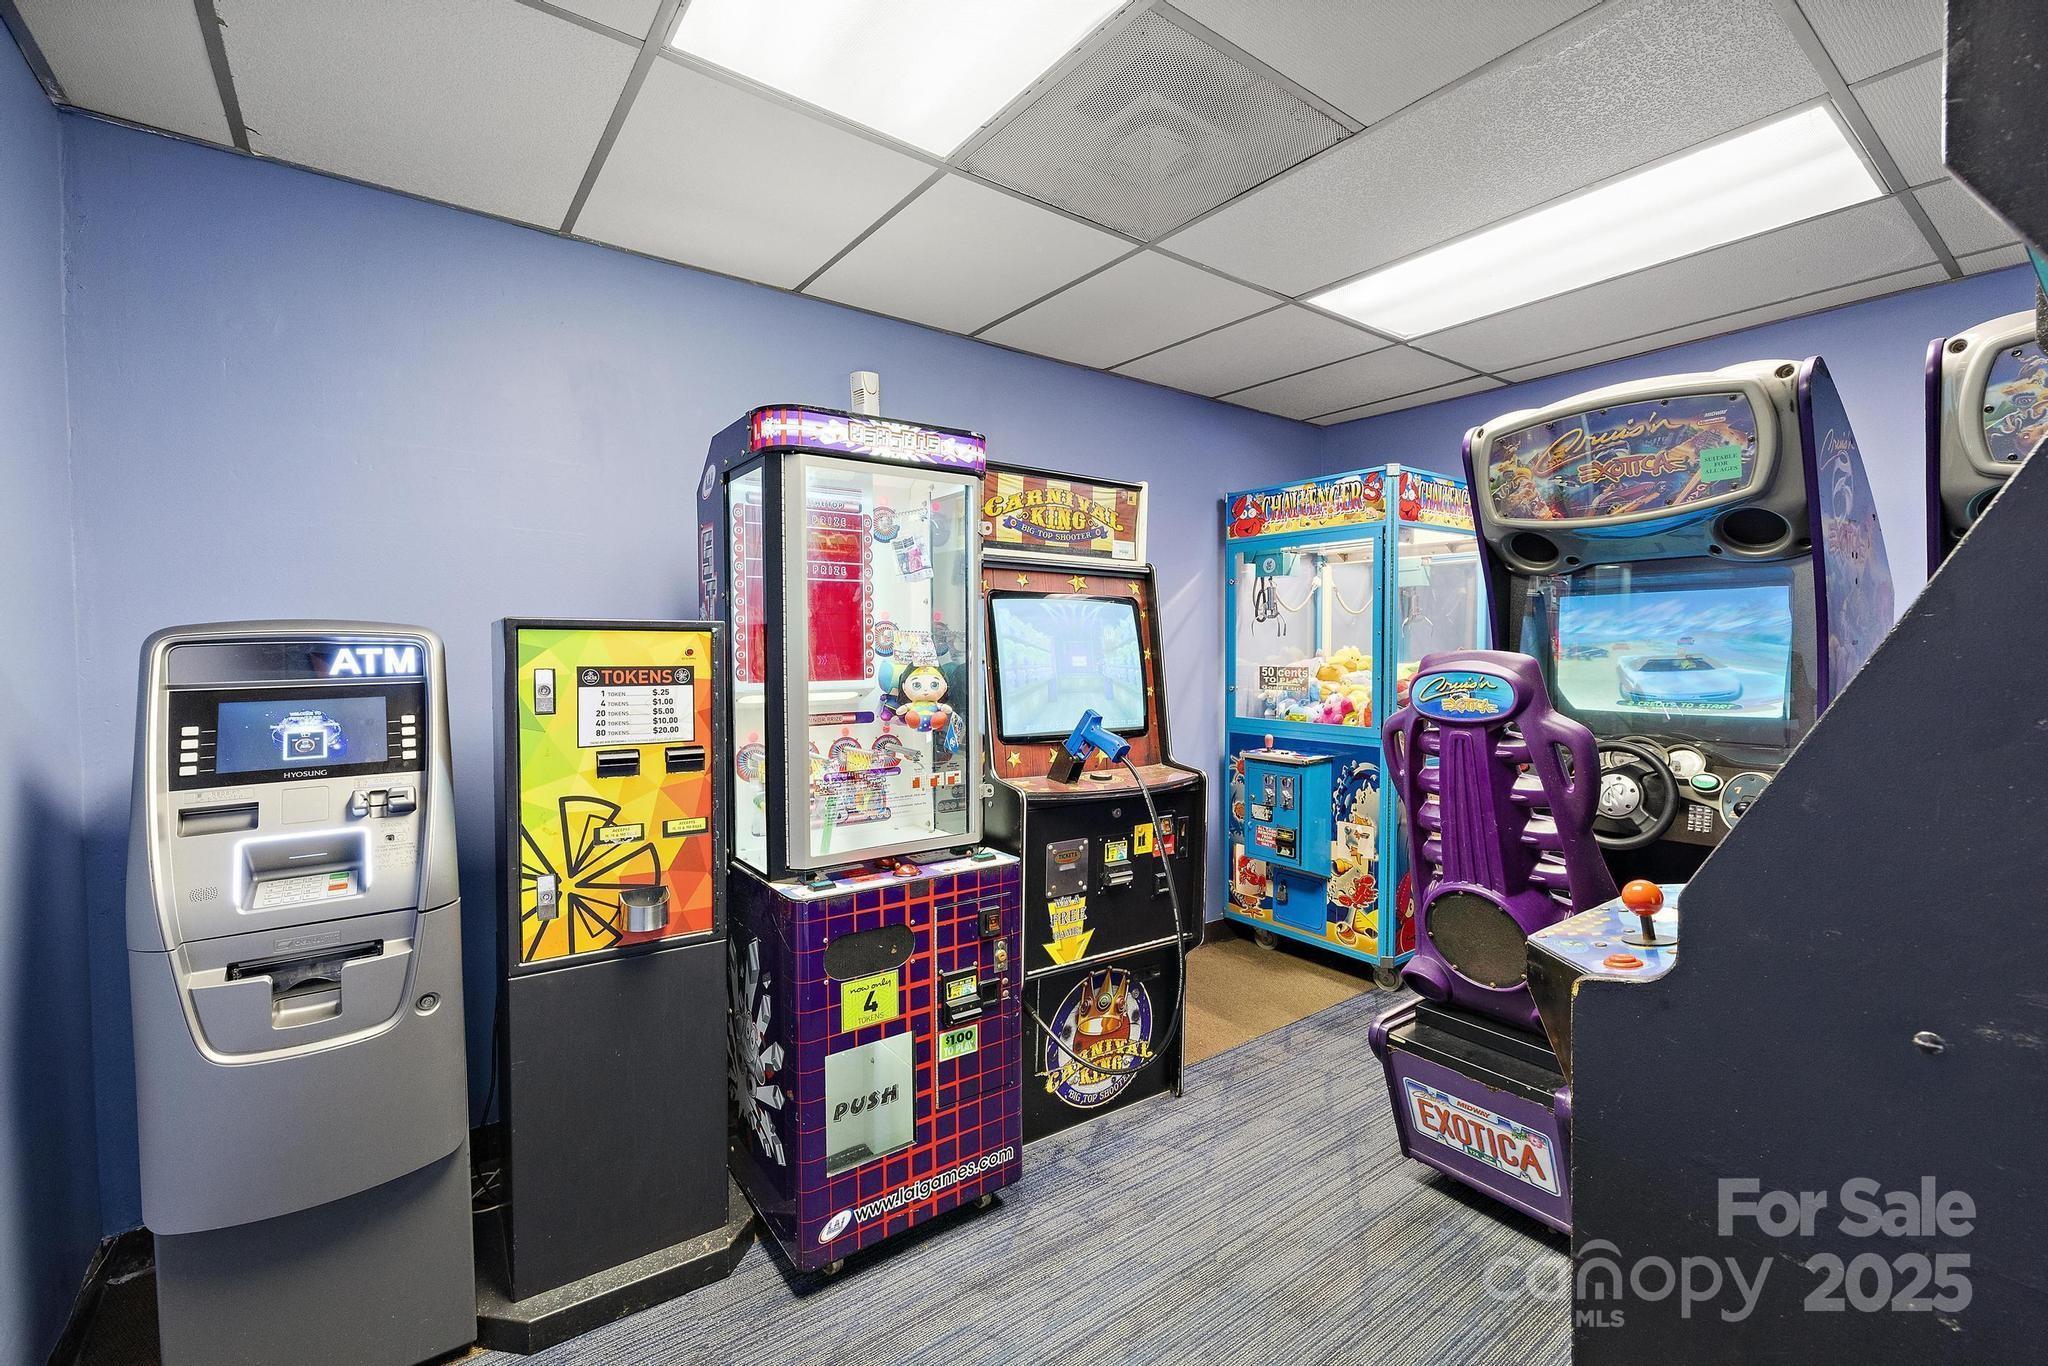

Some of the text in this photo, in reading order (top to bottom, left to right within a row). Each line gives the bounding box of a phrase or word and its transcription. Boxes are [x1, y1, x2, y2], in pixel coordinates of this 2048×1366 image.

[1534, 411, 1686, 477] Cruis'n
[1704, 453, 1738, 463] SUITABLE
[1577, 450, 1687, 485] EXOTICA
[1719, 465, 1739, 473] AGES
[1262, 480, 1364, 521] CHALLENGER
[982, 488, 1125, 532] CARNIVAL
[811, 515, 847, 527] PRIZE
[1030, 505, 1087, 531] KING
[1021, 523, 1092, 542] BIG TOP SHOOTER
[812, 565, 847, 576] PRIZE
[328, 647, 417, 675] ATM
[601, 669, 673, 684] TOKENS
[1261, 666, 1309, 678] 50 cents
[652, 688, 670, 696] $.25
[1419, 675, 1498, 702] Cruis'n
[652, 698, 674, 706] $1.00
[652, 707, 675, 716] $5.00
[652, 716, 679, 725] $10.00
[596, 729, 606, 737] 80
[652, 726, 680, 735] $20.00
[283, 769, 328, 778] HYOSUNG
[1058, 851, 1078, 860] TICKETS
[1050, 906, 1088, 928] FREE
[849, 978, 894, 996] now only
[863, 991, 878, 1013] 4
[857, 1010, 885, 1025] TOKENS
[945, 1030, 973, 1045] $1.00
[944, 1041, 975, 1057] TO PLAY
[833, 1084, 899, 1123] PUSH
[1068, 1089, 1081, 1102] BIG
[1083, 1094, 1098, 1104] TOP
[1456, 1100, 1491, 1119] MIDWAY
[1417, 1098, 1547, 1181] EXOTICA
[854, 1147, 1014, 1223] www.laigames.com
